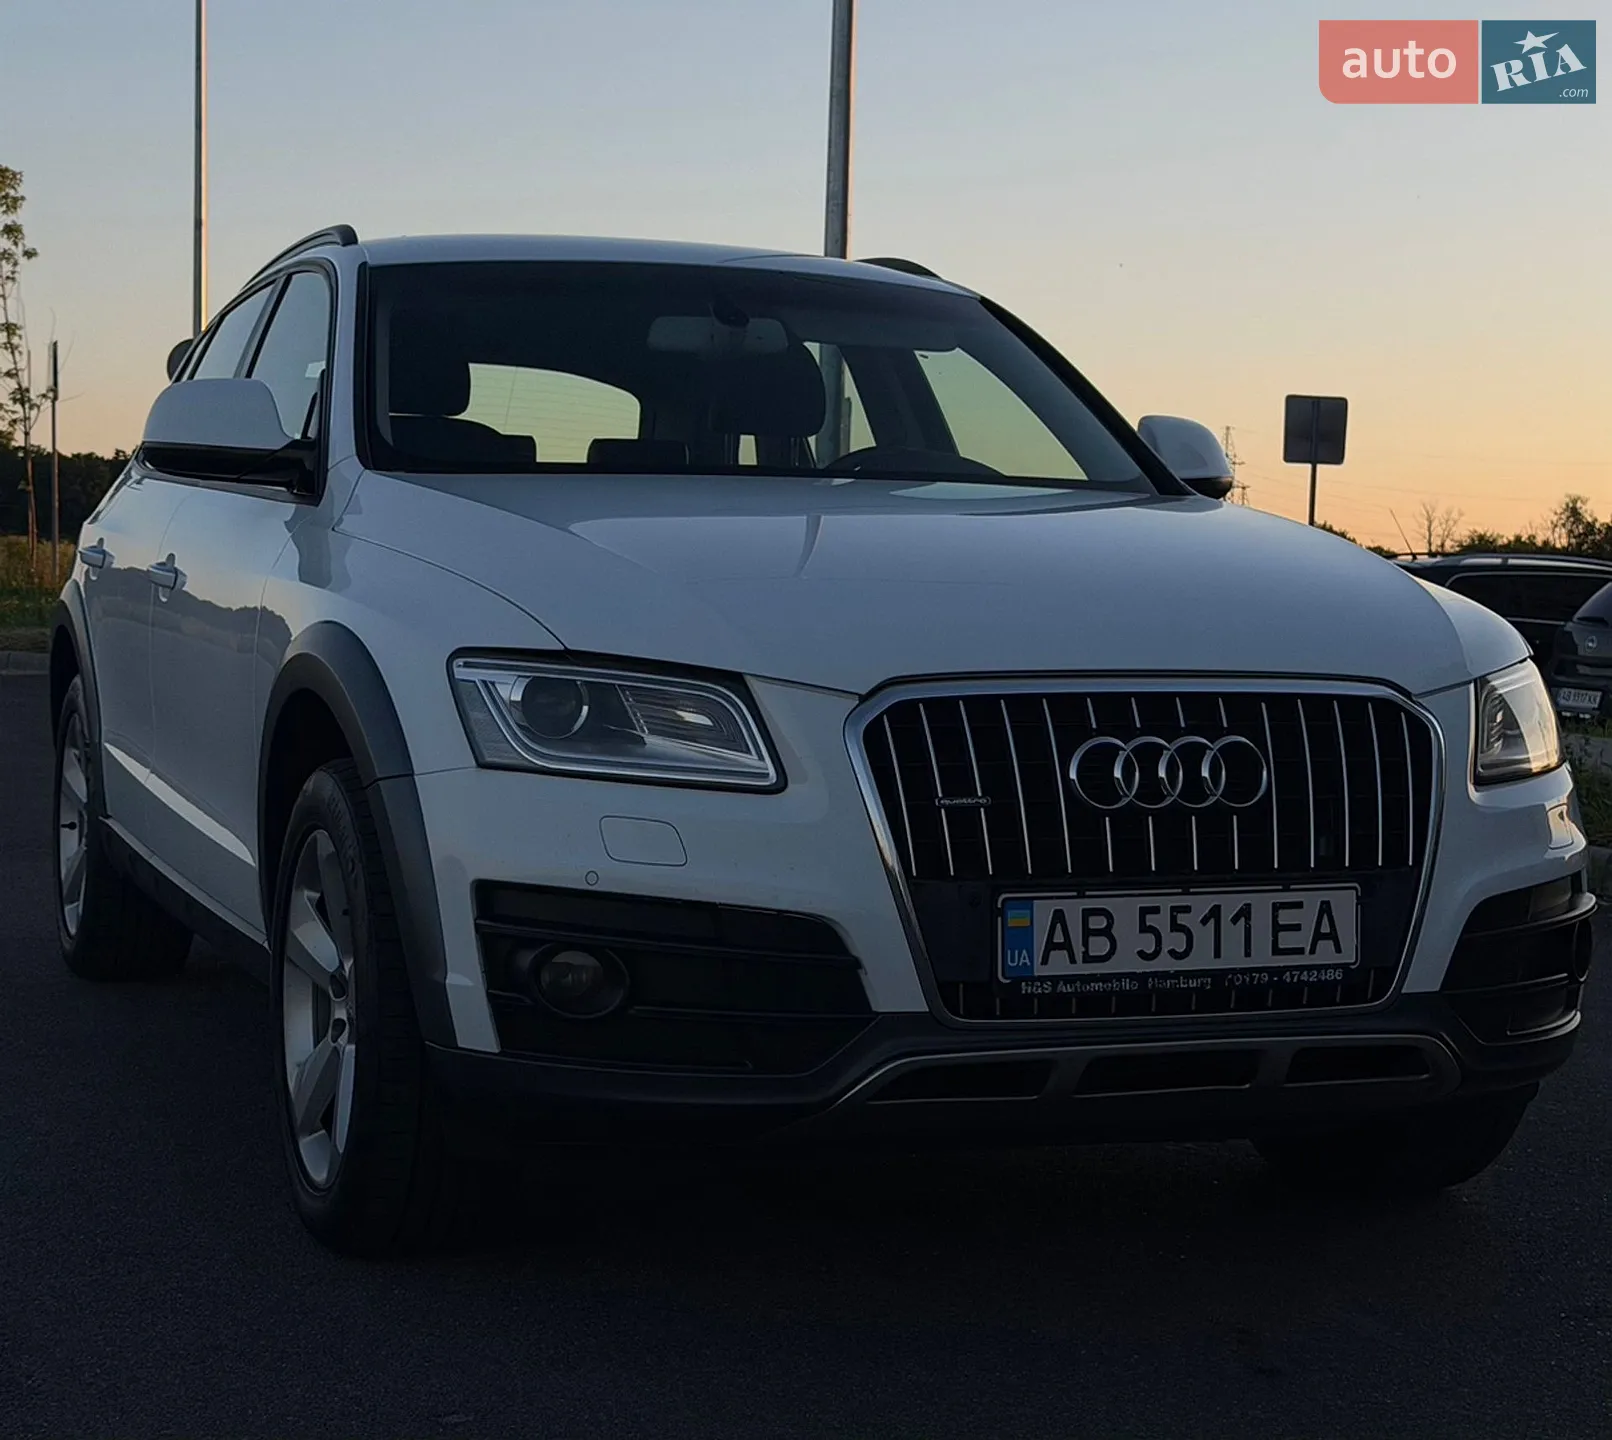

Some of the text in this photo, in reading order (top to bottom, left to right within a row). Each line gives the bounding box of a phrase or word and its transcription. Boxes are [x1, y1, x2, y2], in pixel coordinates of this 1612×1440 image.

[1040, 899, 1342, 967] AB 5511 EA
[1007, 949, 1031, 967] UA
[1148, 975, 1212, 991] Hamburg
[1282, 968, 1344, 984] 4742486
